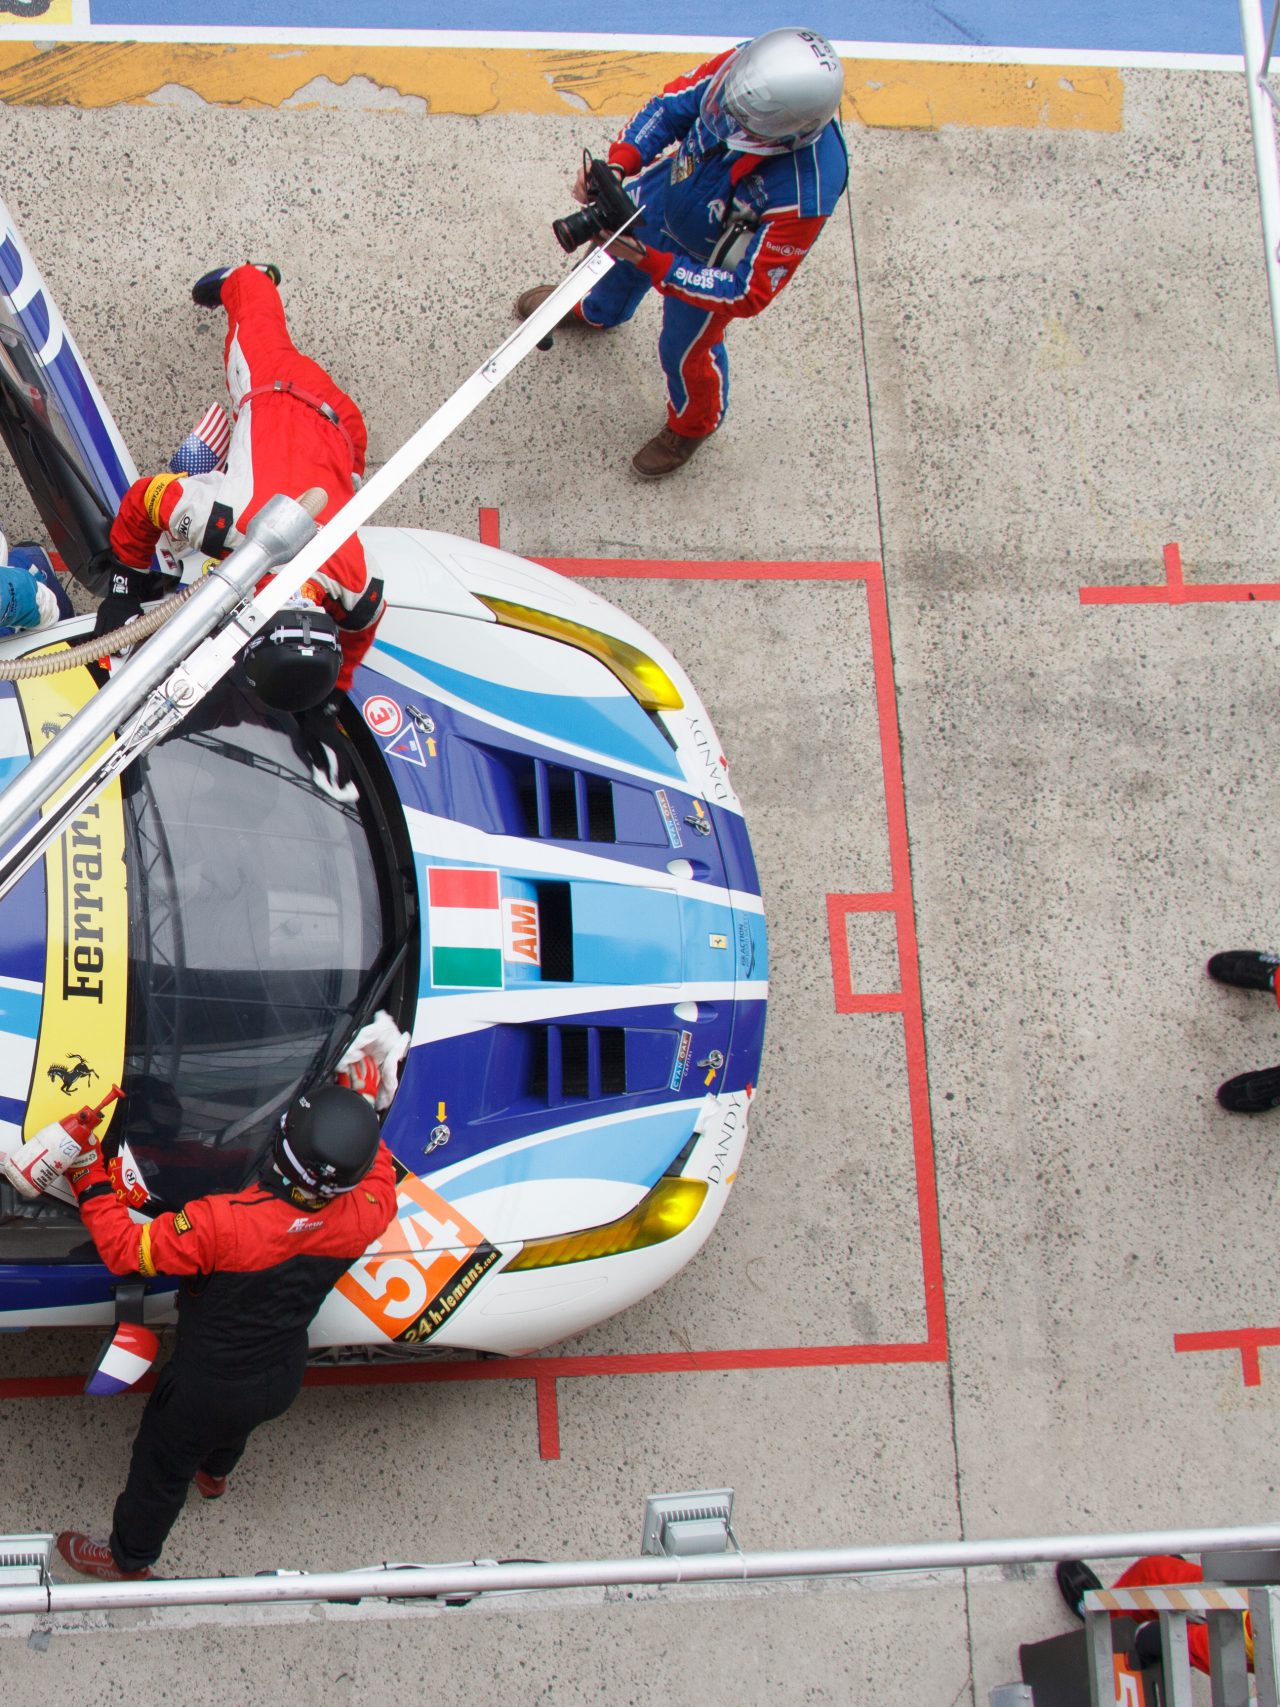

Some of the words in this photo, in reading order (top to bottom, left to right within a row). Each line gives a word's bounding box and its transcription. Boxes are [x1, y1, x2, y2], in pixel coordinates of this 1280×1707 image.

[797, 32, 831, 71] JPG
[685, 716, 727, 800] DANDY
[511, 904, 537, 961] AM
[673, 1063, 683, 1089] CYAN
[679, 1036, 689, 1059] OAK
[708, 1094, 741, 1185] DANDY
[174, 1209, 192, 1234] OMP
[347, 1192, 470, 1319] 54
[405, 1320, 433, 1343] 24
[429, 1252, 498, 1326] h-lemans.com
